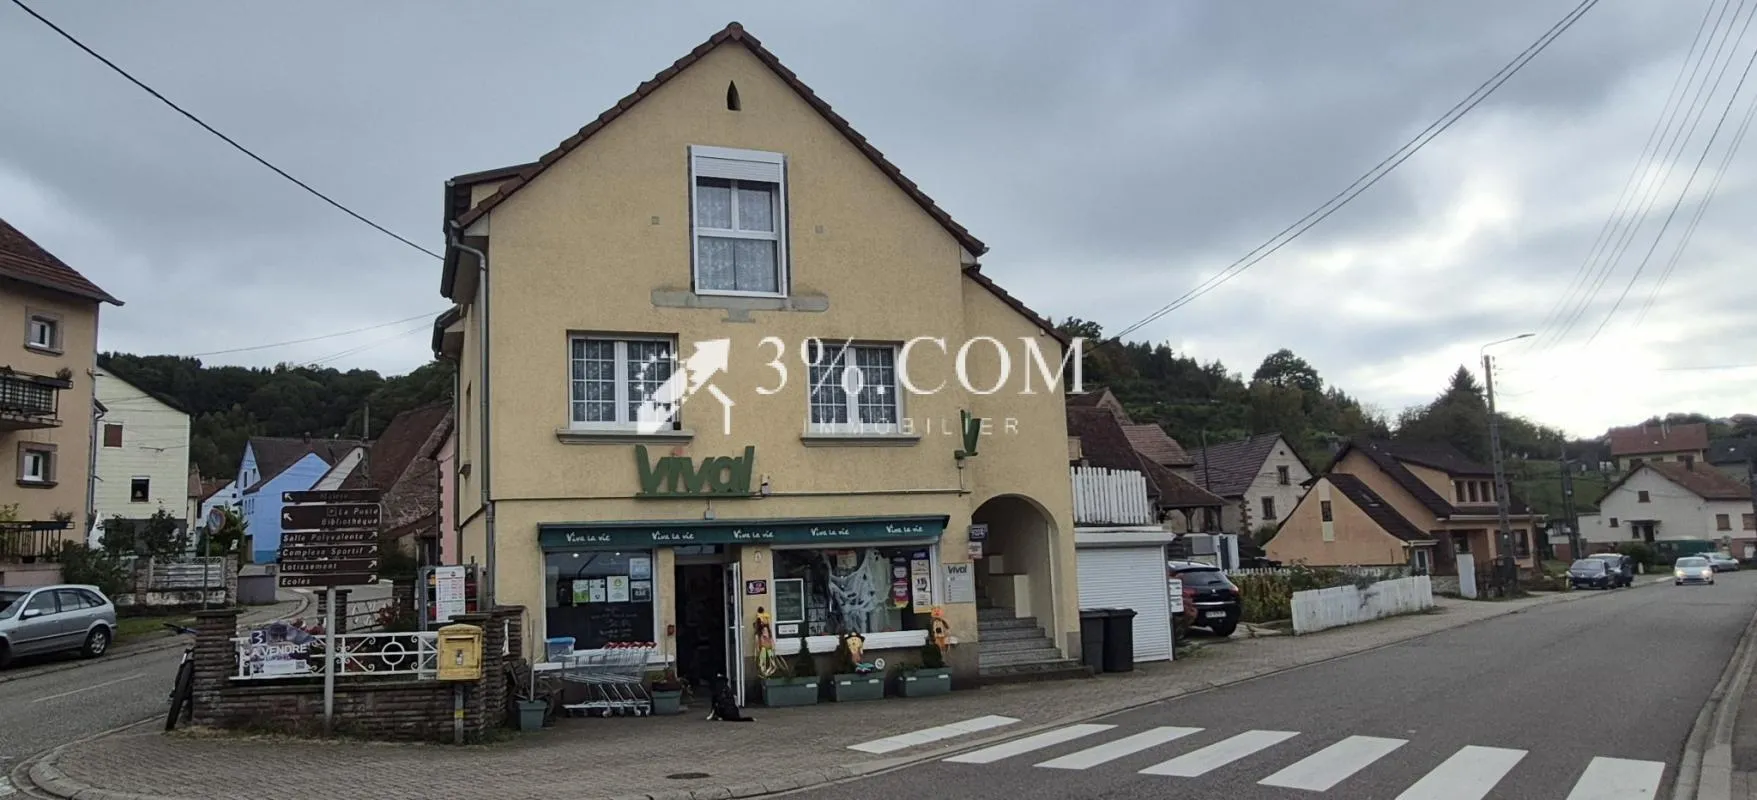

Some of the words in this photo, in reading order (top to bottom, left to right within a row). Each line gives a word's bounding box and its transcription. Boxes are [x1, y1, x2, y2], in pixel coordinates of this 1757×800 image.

[635, 444, 755, 493] Vival
[733, 529, 751, 539] Vive
[811, 528, 828, 537] Vive
[886, 525, 903, 534] Vive
[283, 534, 306, 542] Salle
[311, 533, 364, 543] Polyvalente
[566, 532, 585, 542] Vive
[652, 531, 670, 540] Vive
[282, 548, 326, 558] Complexe
[331, 546, 364, 557] Sportif
[282, 563, 337, 571] Lotissement
[947, 564, 968, 574] Vival
[282, 577, 311, 586] Ecoles
[262, 644, 308, 657] VENDRE
